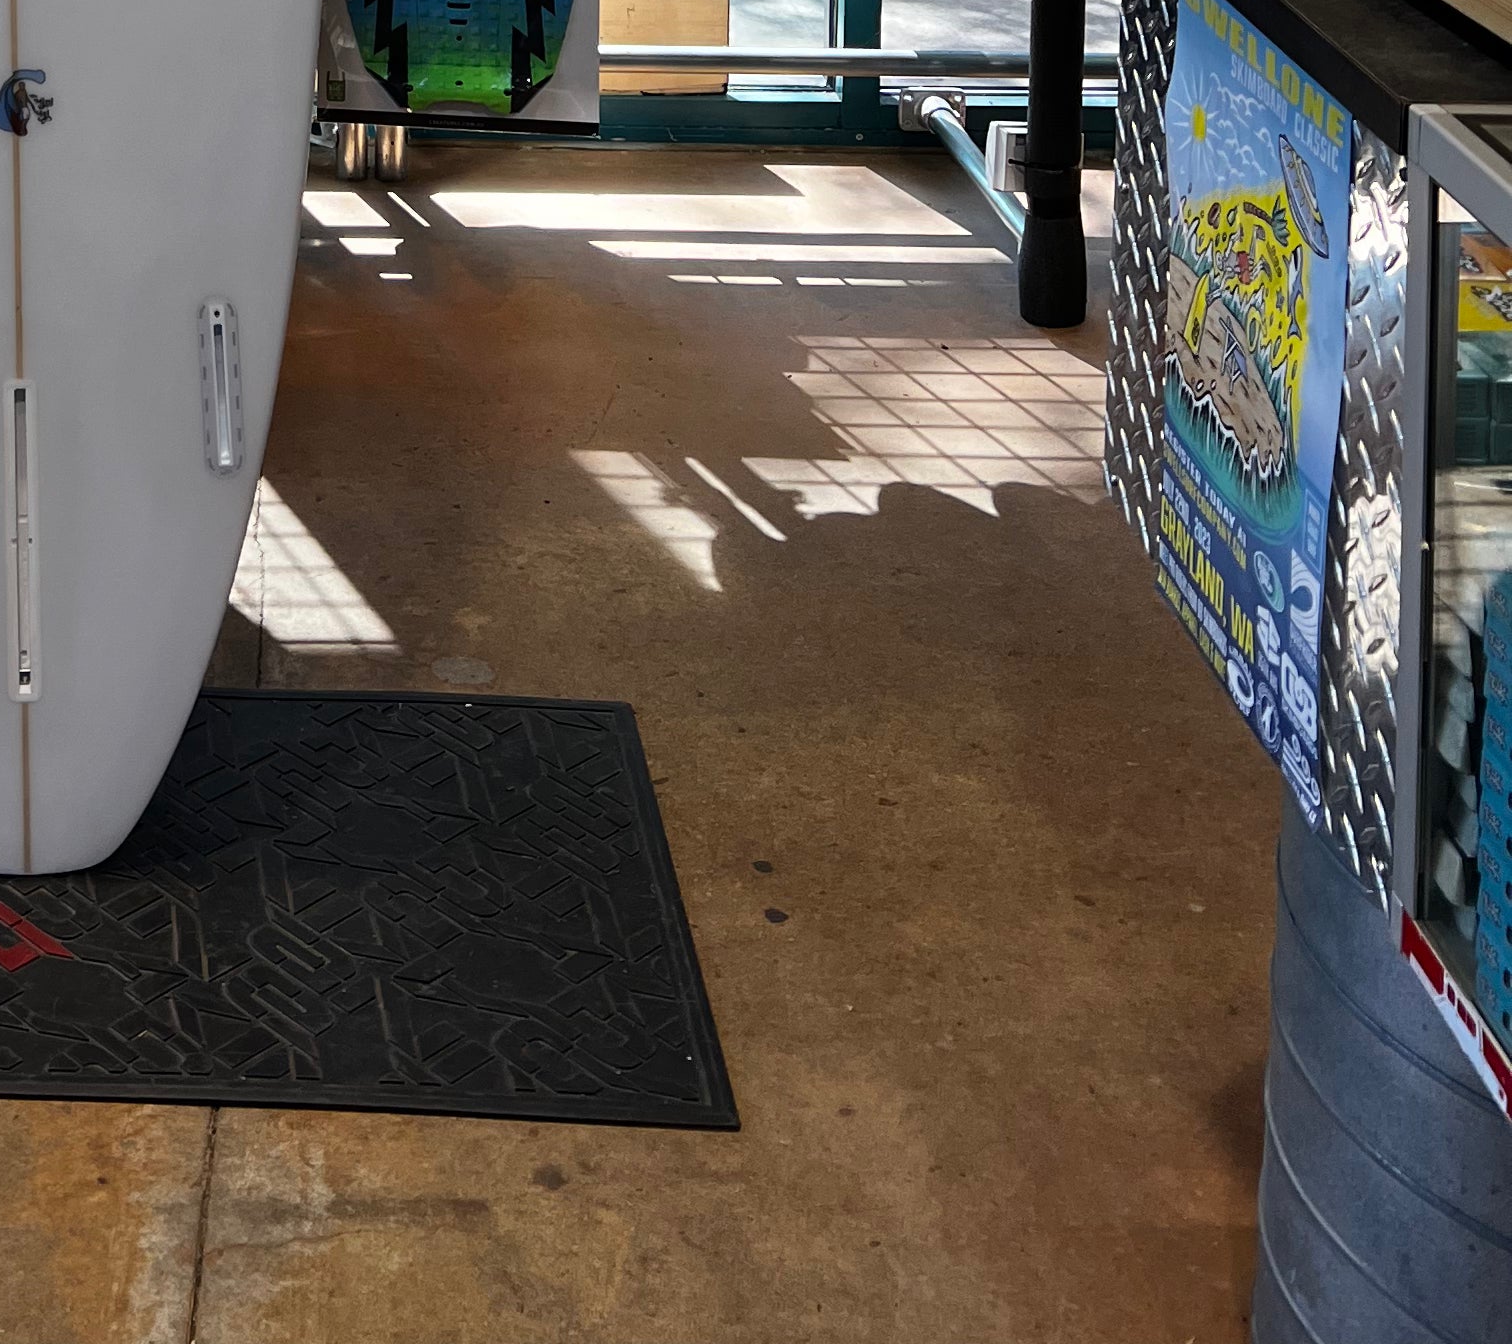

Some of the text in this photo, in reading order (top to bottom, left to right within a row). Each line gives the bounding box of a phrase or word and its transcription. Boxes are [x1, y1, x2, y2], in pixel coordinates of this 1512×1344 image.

[1230, 54, 1340, 174] SKIMBOARD CLASSIC
[1164, 422, 1202, 486] REGISTER
[1204, 481, 1235, 529] TODAY
[1230, 593, 1255, 665] WA
